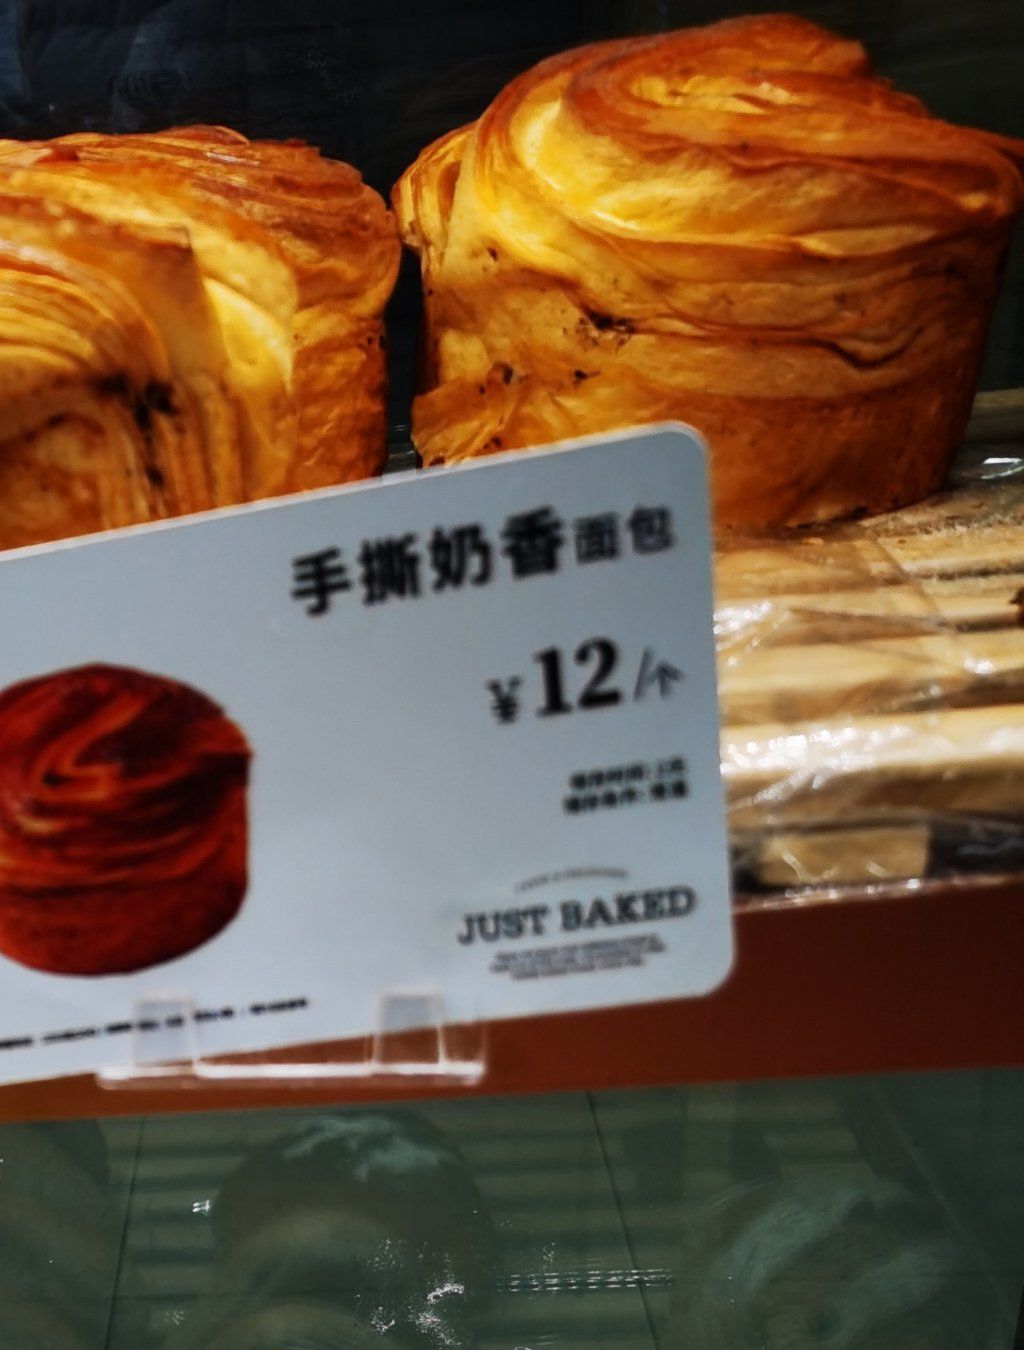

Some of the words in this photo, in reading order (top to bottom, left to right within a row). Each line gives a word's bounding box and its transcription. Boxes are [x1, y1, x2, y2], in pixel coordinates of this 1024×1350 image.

[290, 504, 677, 618] 手撕奶香面包
[456, 904, 550, 946] JUST
[559, 884, 697, 932] BAKED
